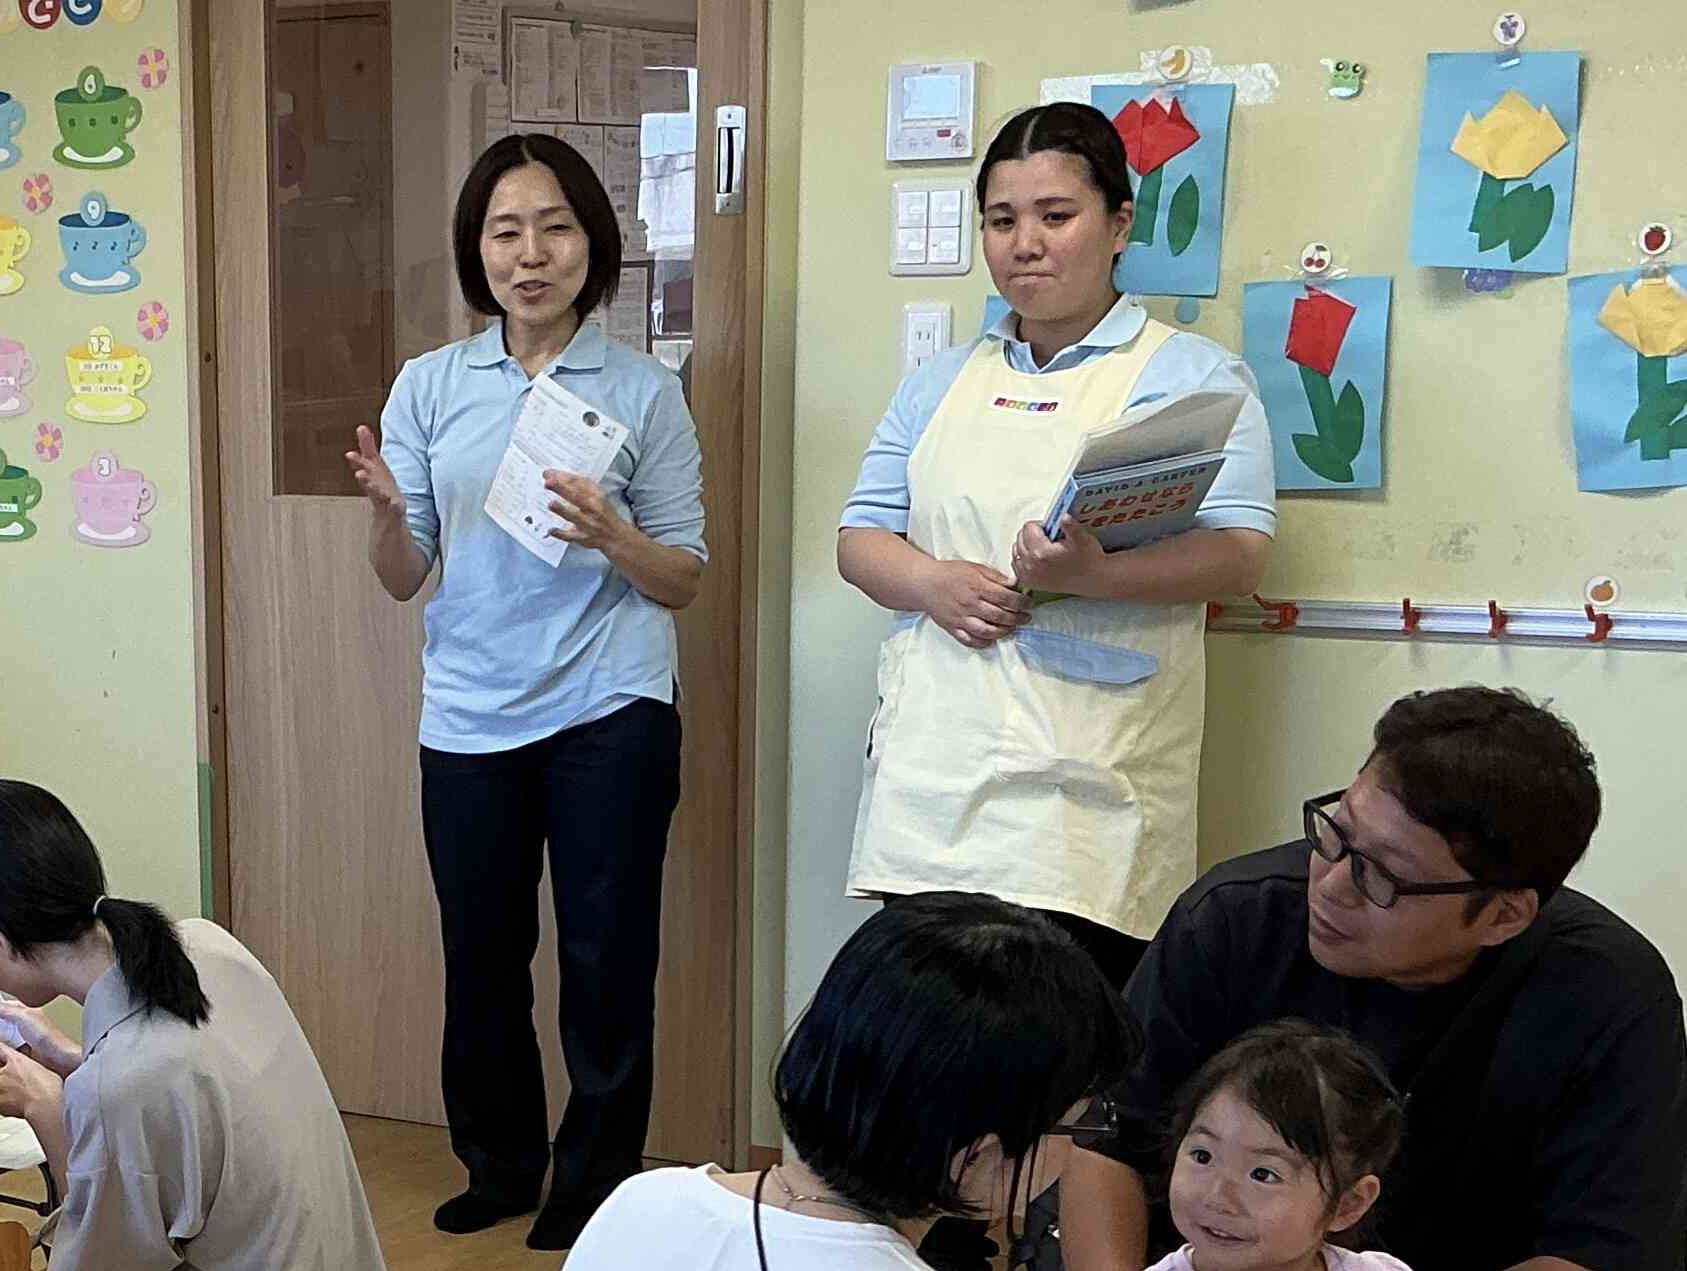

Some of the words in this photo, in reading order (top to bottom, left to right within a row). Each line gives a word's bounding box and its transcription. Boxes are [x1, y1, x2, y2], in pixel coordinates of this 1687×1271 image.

[82, 73, 98, 95] 6
[86, 200, 101, 221] 9
[88, 335, 113, 354] 12
[97, 458, 112, 477] 3
[1085, 483, 1129, 497] DAVID
[1151, 466, 1208, 485] CARTER
[1080, 481, 1195, 515] しあわせなら
